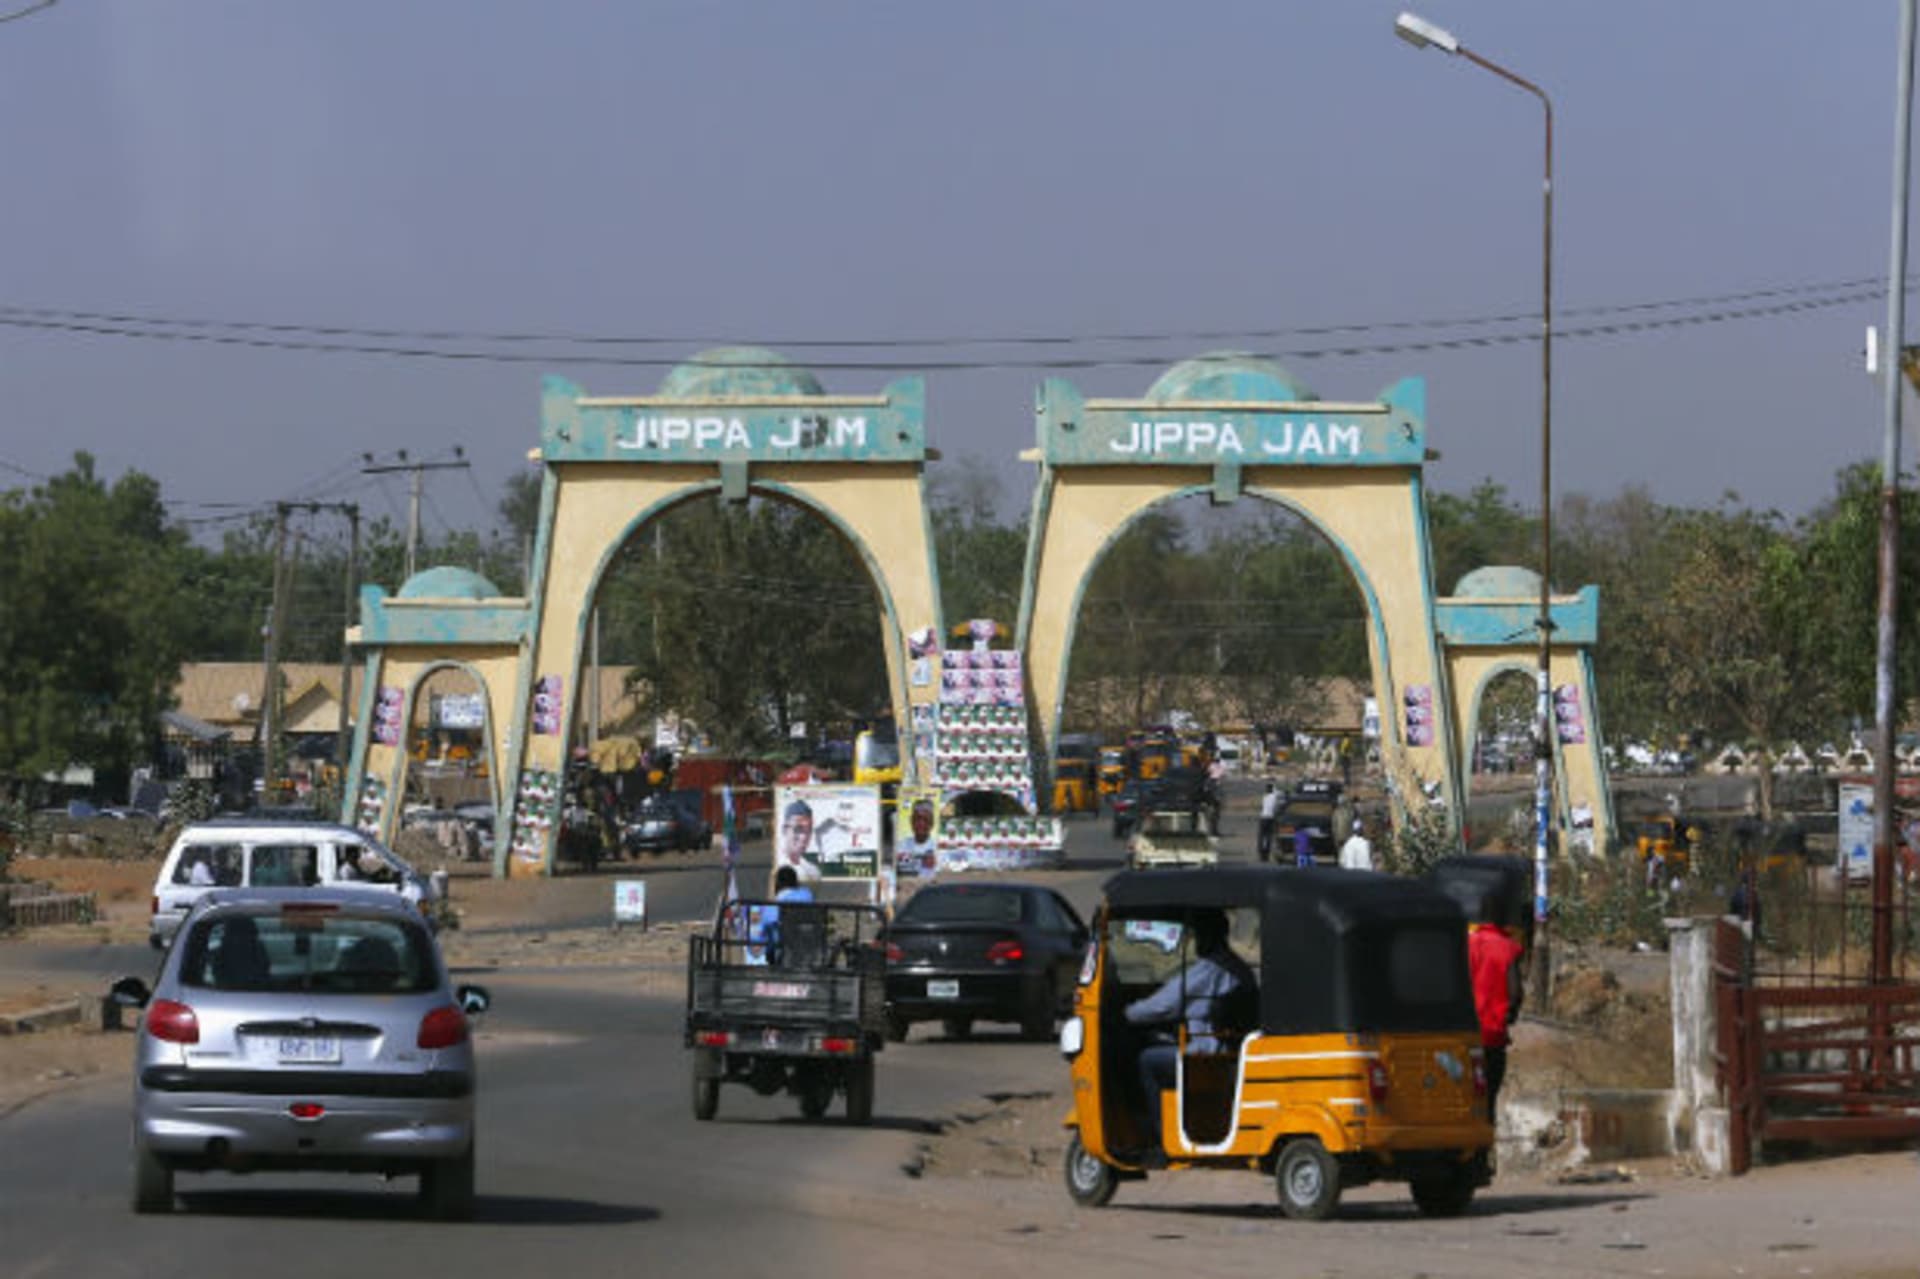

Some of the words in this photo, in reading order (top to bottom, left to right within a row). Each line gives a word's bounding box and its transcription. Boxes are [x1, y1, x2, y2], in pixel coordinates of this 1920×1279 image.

[616, 416, 751, 449] JIPPA
[769, 415, 866, 448] JM
[1109, 421, 1244, 455] JIPPA
[1262, 420, 1361, 455] JAM
